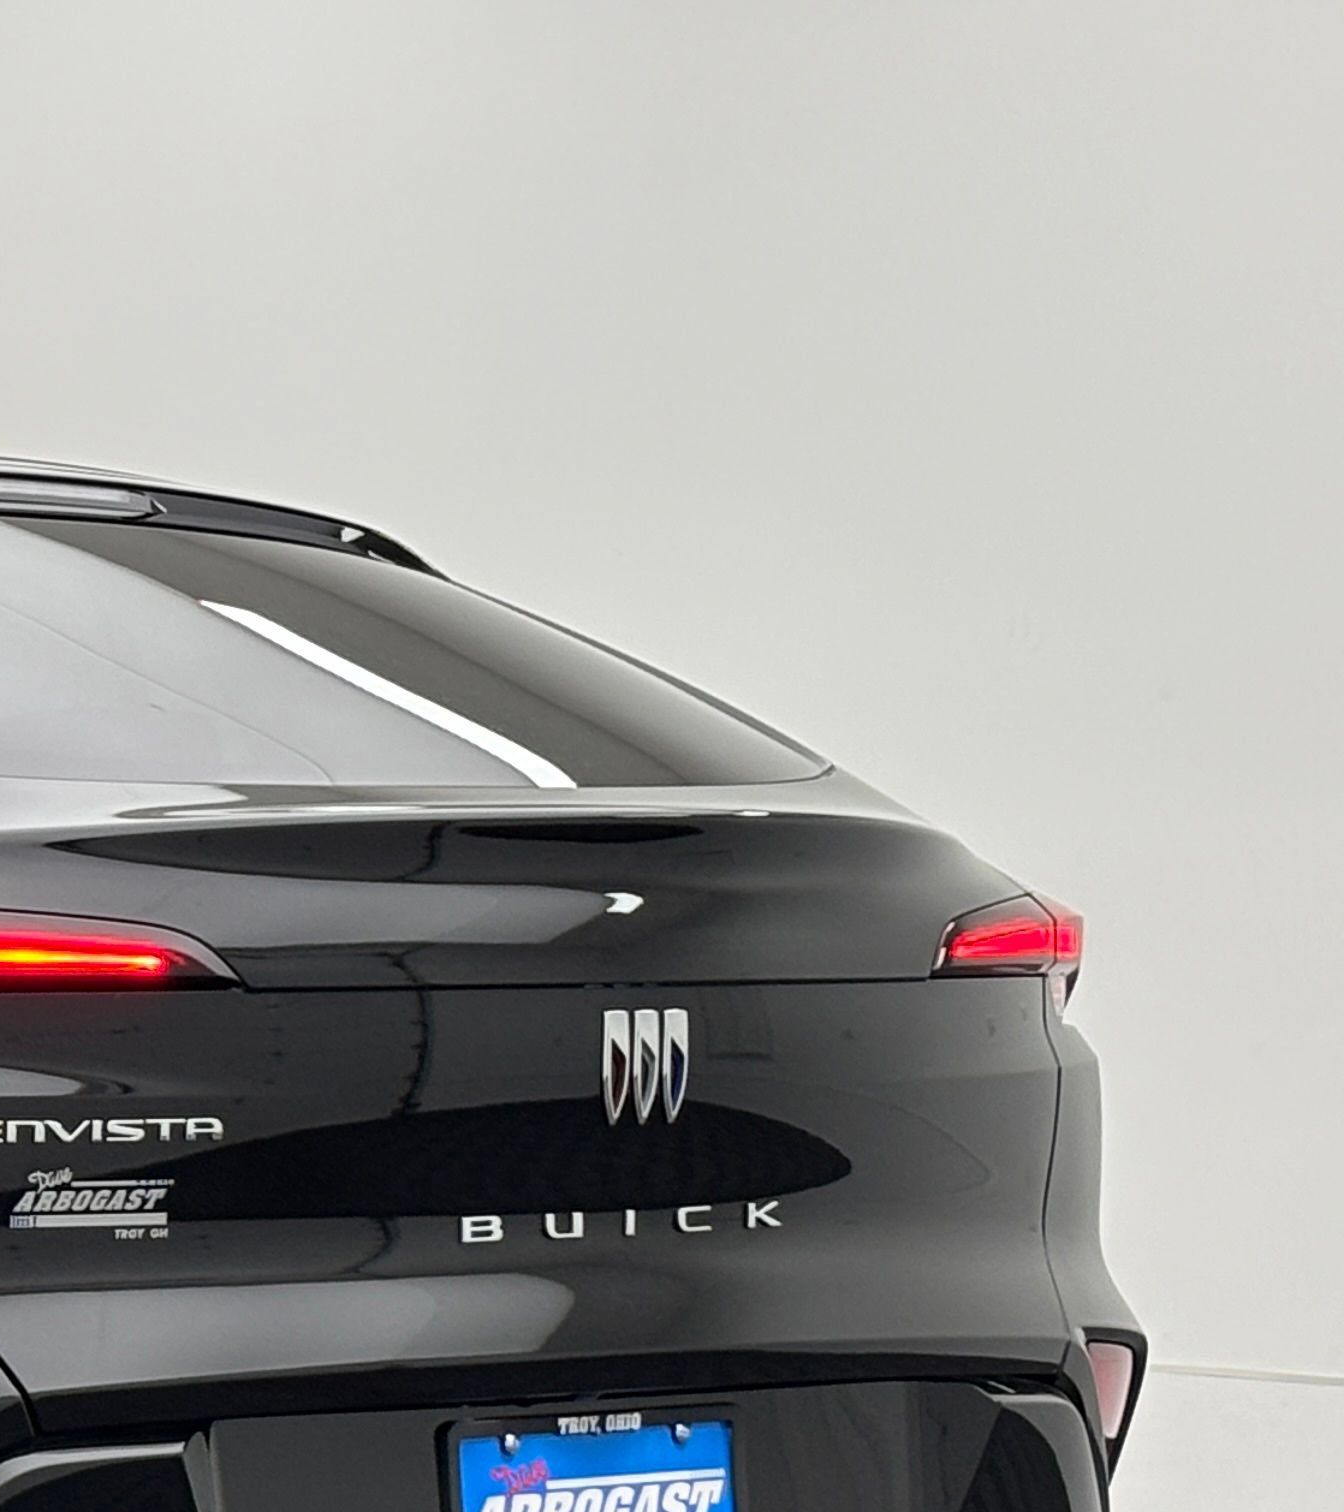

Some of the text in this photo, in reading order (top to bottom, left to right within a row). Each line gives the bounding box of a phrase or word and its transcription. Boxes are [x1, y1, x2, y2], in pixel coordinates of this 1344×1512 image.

[12, 1188, 167, 1212] ARBOGAST
[460, 1200, 783, 1243] BUICK
[114, 1228, 144, 1240] TROY
[605, 1412, 642, 1431] OHIO
